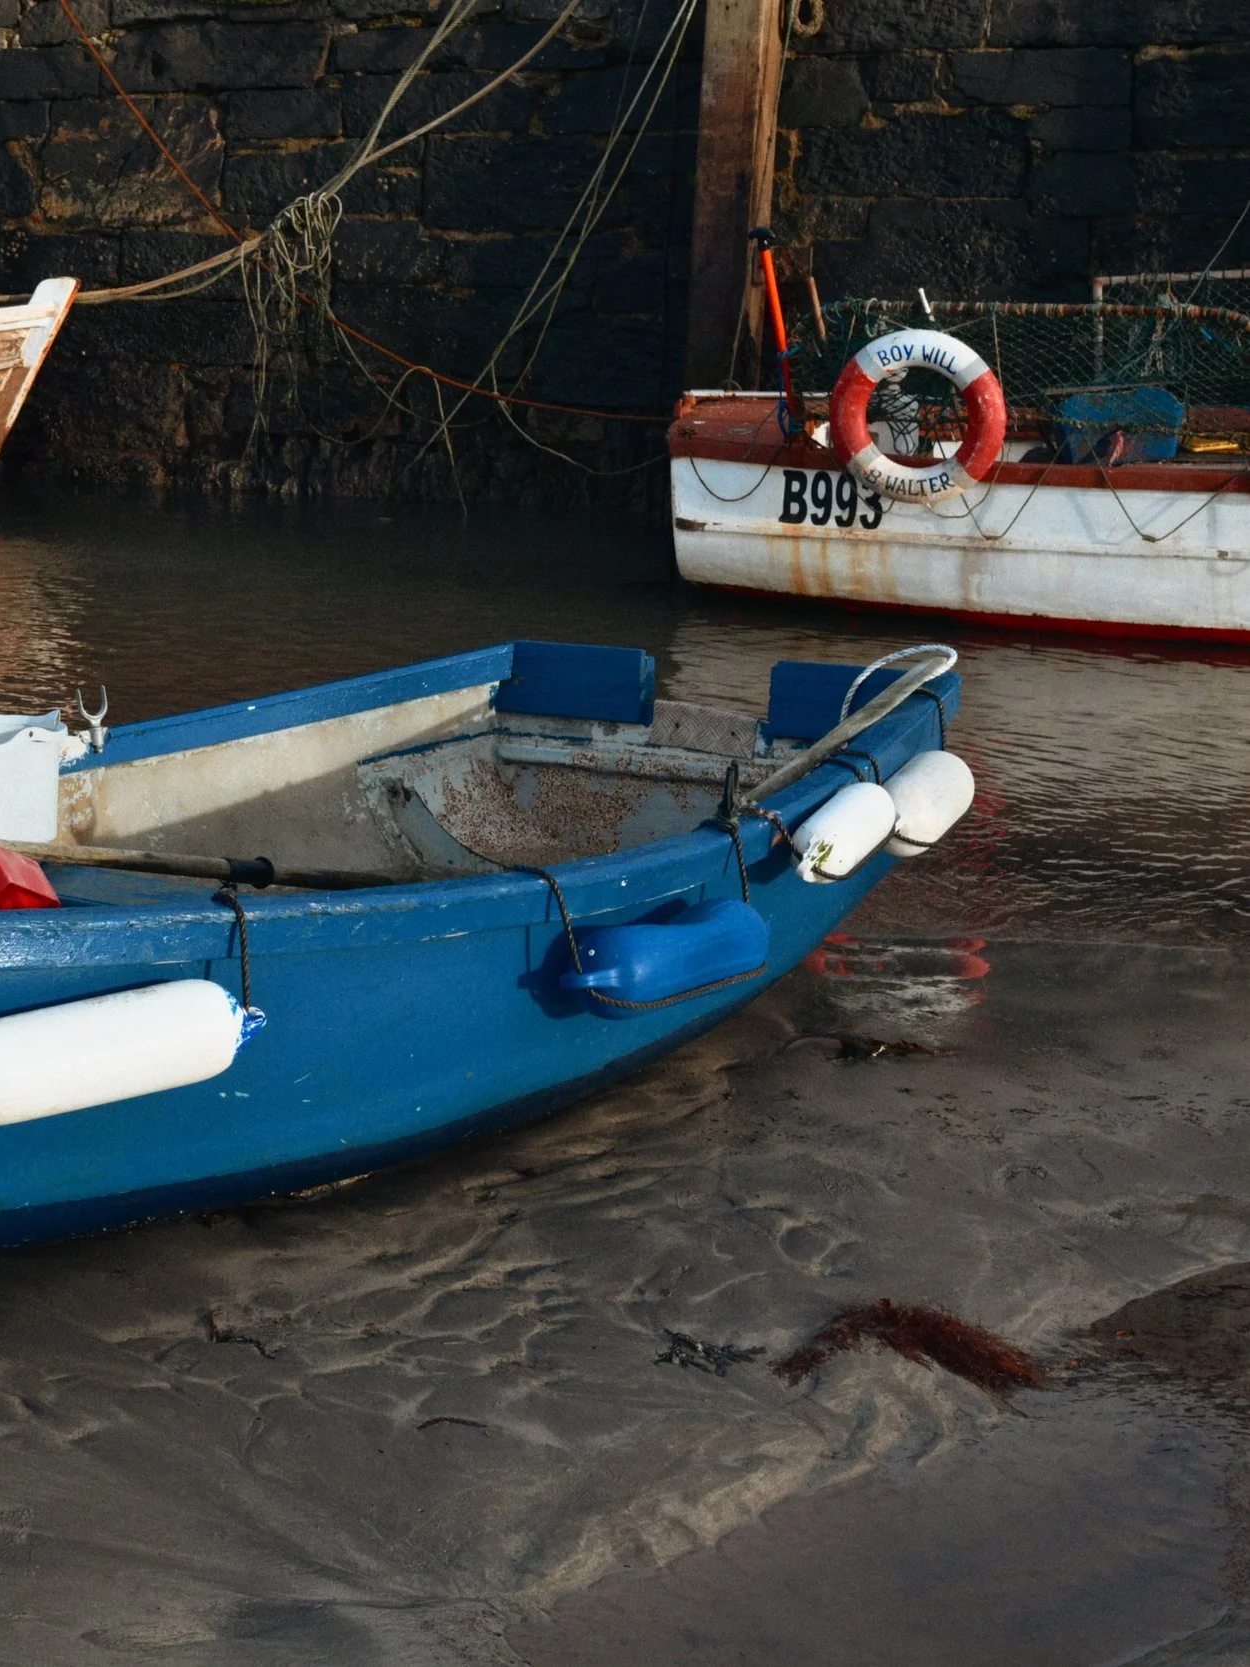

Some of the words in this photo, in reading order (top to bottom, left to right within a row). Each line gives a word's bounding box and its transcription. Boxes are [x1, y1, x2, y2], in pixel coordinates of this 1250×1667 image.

[922, 344, 957, 375] WILL
[778, 469, 883, 530] B993
[885, 472, 955, 496] WALTER
